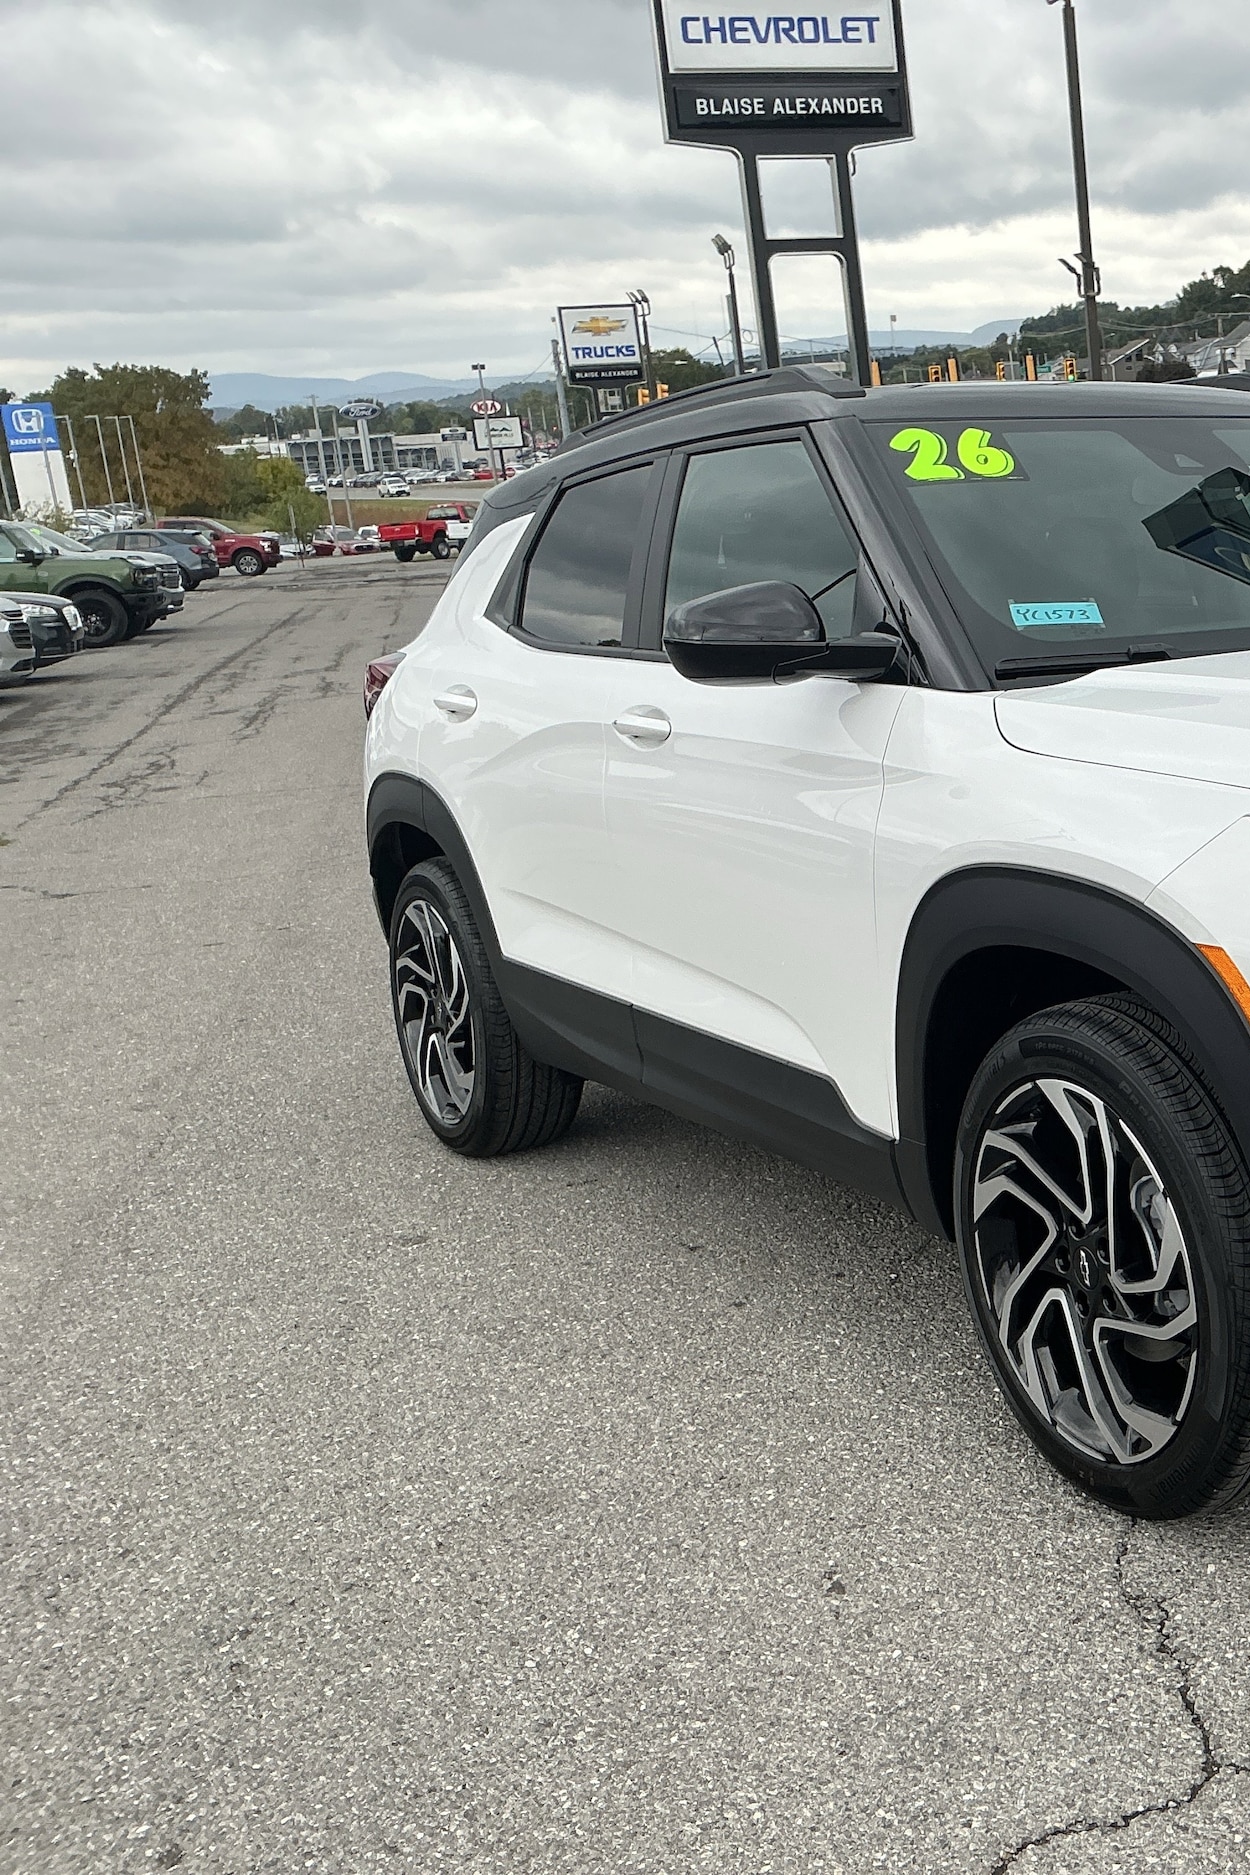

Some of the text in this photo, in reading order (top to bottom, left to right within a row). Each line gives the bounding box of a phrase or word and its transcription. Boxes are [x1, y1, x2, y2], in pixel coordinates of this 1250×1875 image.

[680, 15, 880, 44] CHEVROLET
[695, 96, 884, 116] BLAISE ALEXANDER
[571, 345, 636, 360] TRUCKS
[601, 369, 639, 378] ALEXANDER
[348, 406, 373, 417] Ford
[477, 402, 498, 412] KIA
[889, 427, 1015, 481] 26
